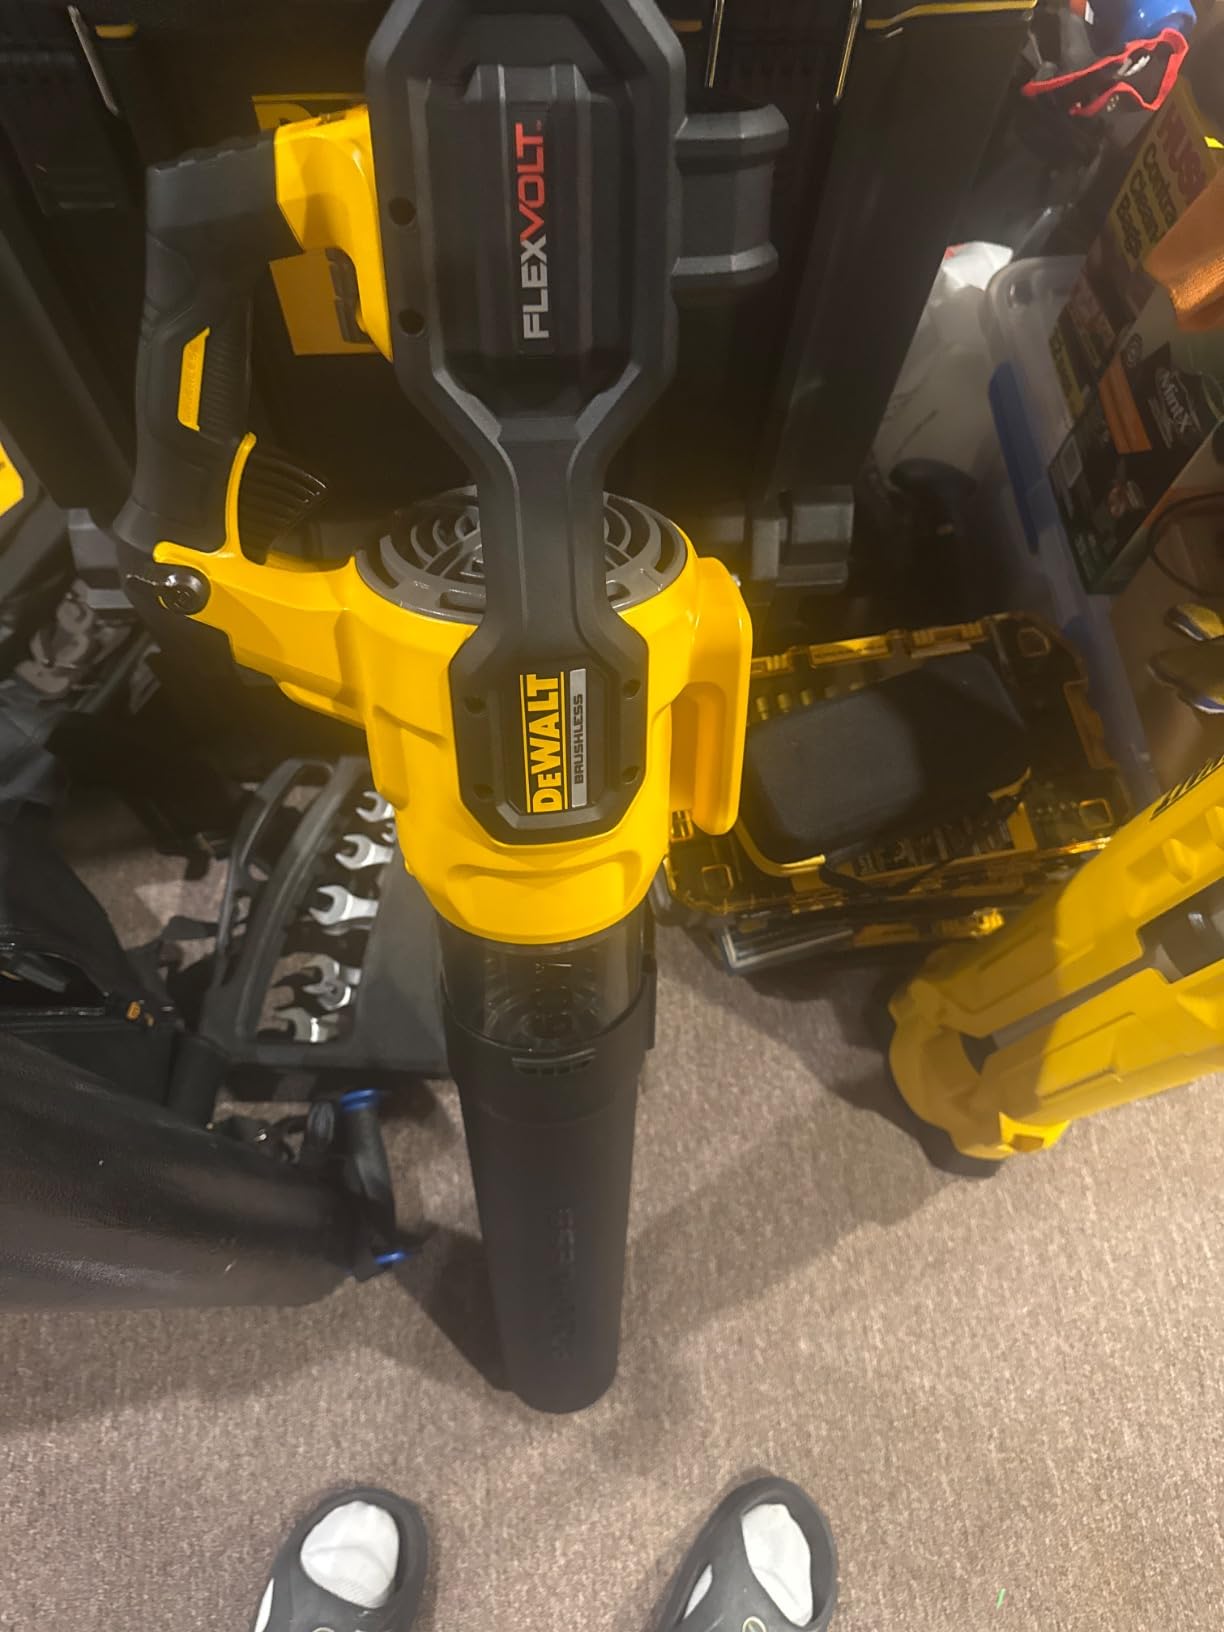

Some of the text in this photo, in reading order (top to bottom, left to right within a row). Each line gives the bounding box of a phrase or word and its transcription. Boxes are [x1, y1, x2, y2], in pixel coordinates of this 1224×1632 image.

[515, 122, 549, 338] FLEXVOLT
[526, 673, 563, 813] DEWALT
[573, 693, 584, 785] BRUSHLESS
